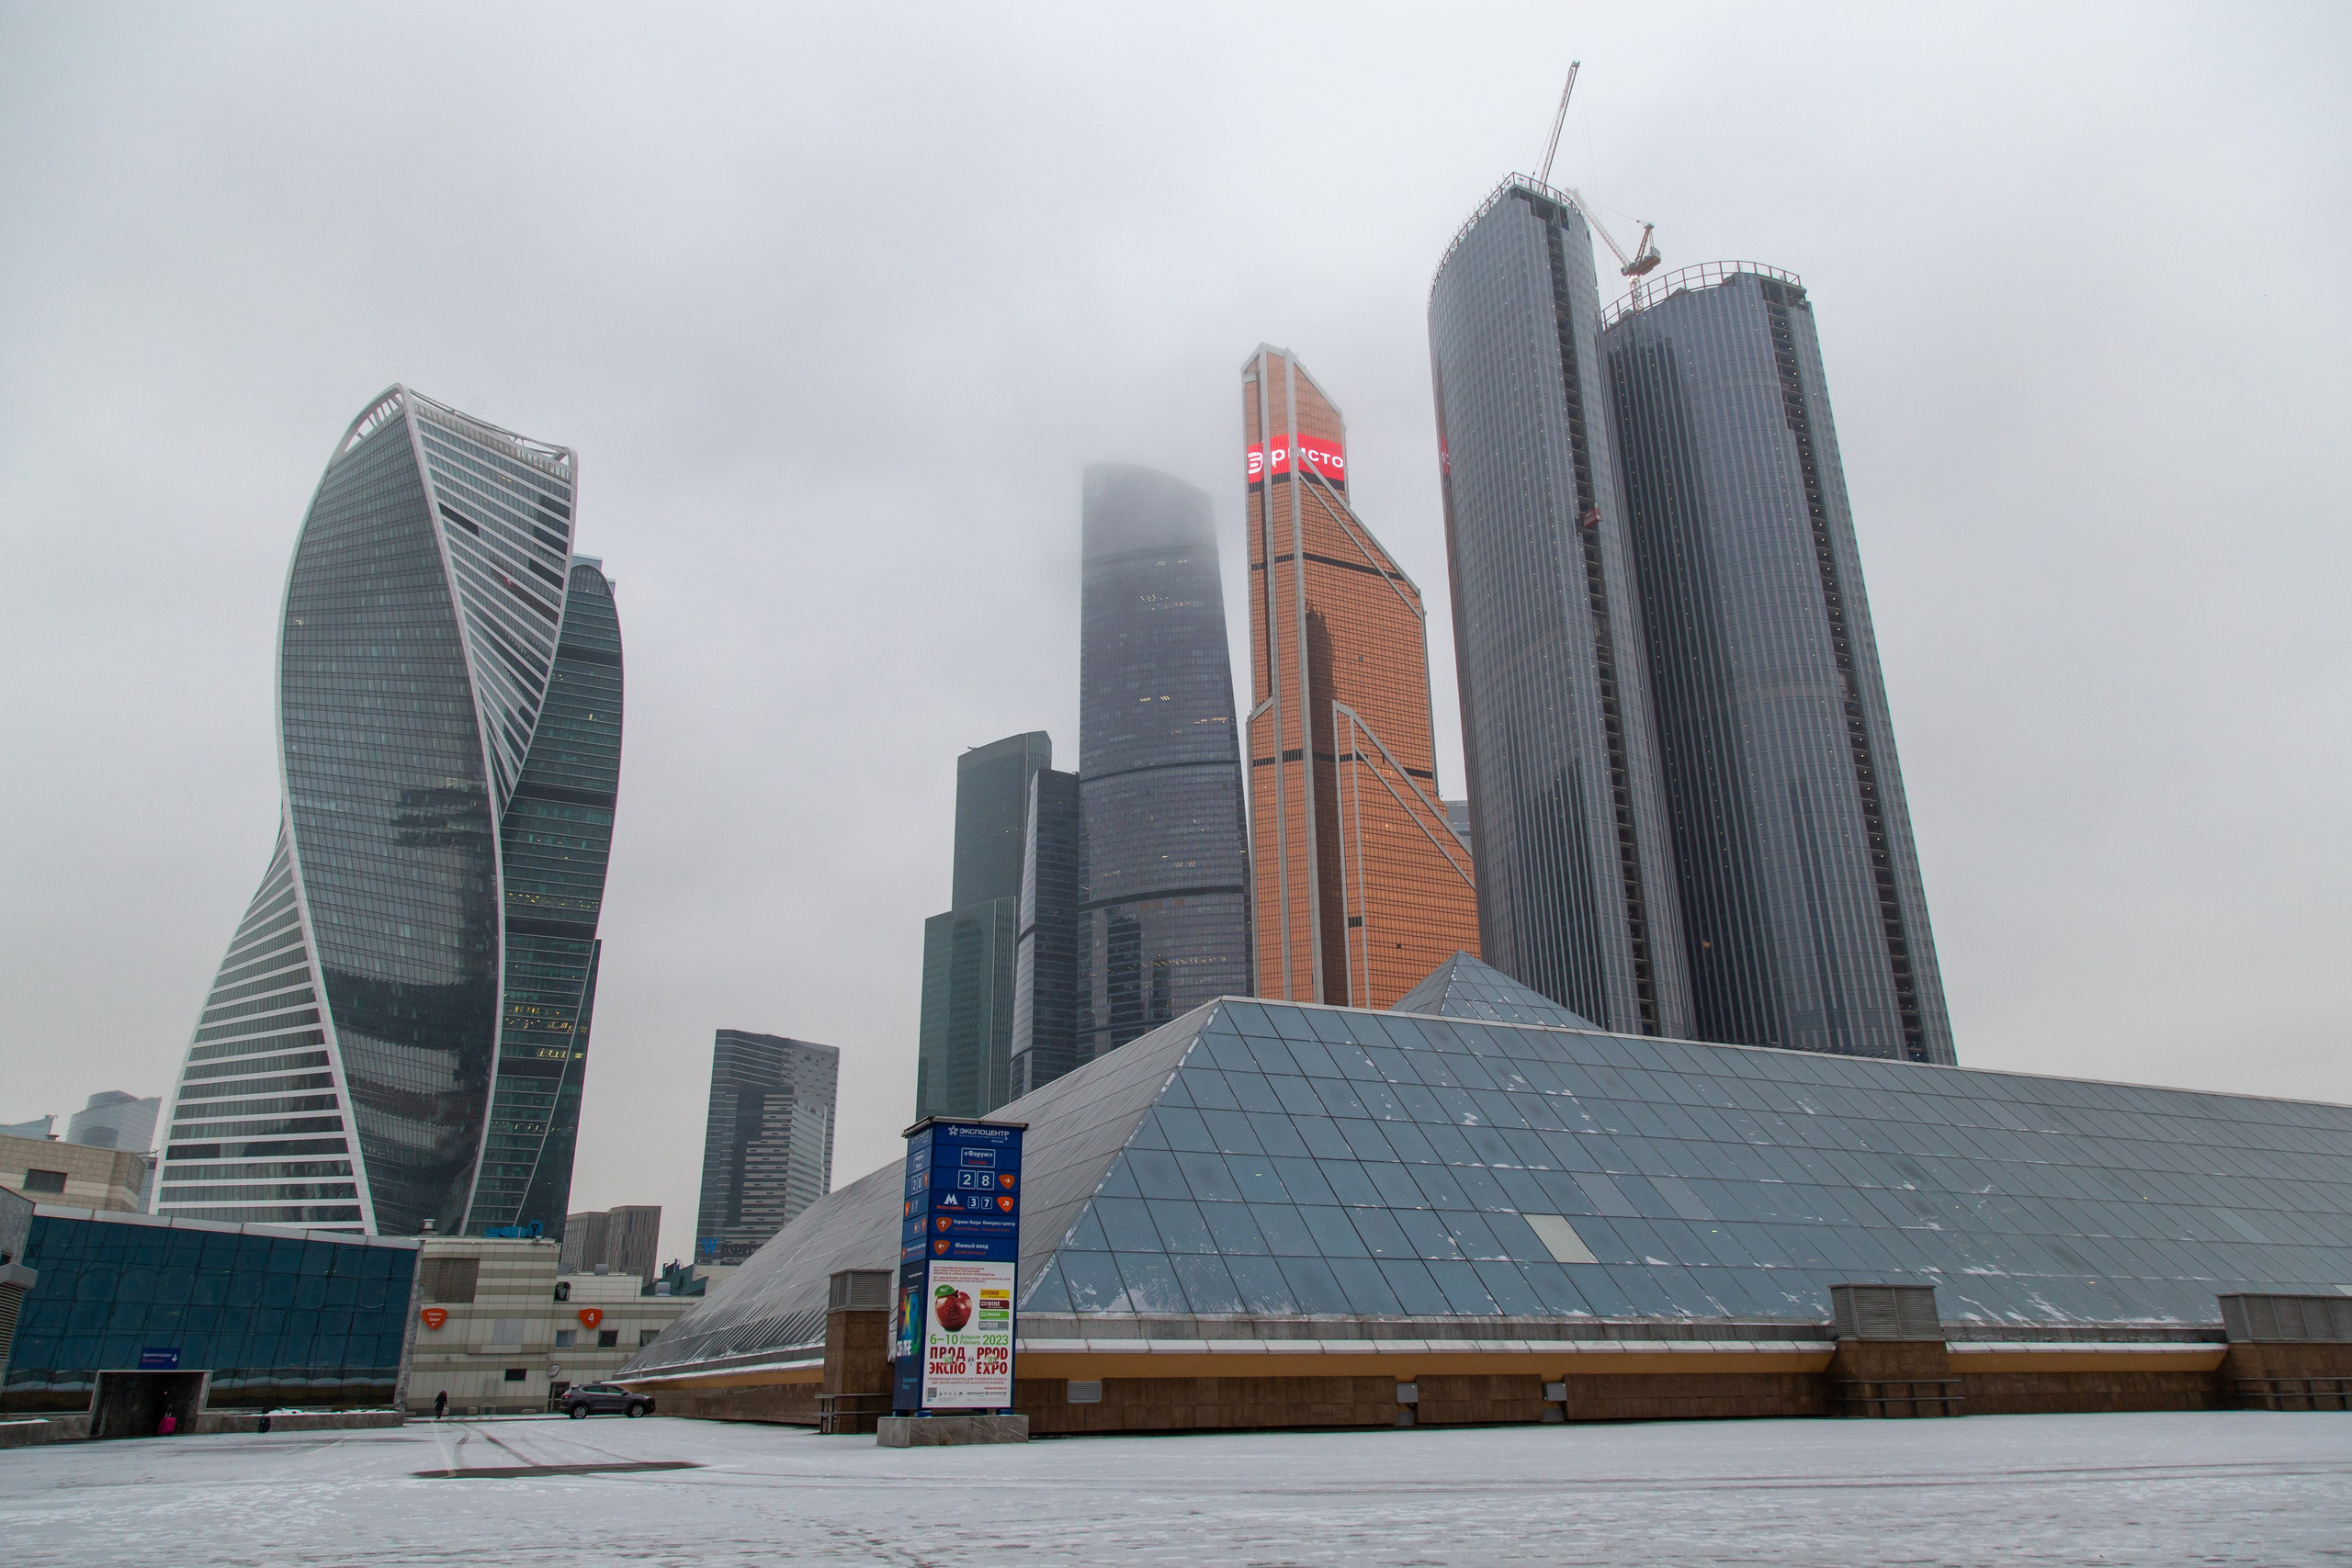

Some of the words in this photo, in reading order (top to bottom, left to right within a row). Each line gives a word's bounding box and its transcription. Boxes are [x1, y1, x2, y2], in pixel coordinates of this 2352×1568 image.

[959, 1128, 1009, 1138] ЭКСПОЦЕНТР
[964, 1150, 993, 1158] «Форум»
[963, 1174, 971, 1185] 2
[981, 1175, 989, 1186] 8
[970, 1198, 977, 1207] 3
[984, 1198, 989, 1207] 7
[588, 1313, 594, 1322] 4
[982, 1335, 1009, 1345] 2023
[930, 1347, 966, 1361] ПРОД
[977, 1347, 1008, 1360] PROD
[929, 1361, 966, 1374] ЭКСПО
[976, 1361, 1008, 1374] EXPO
